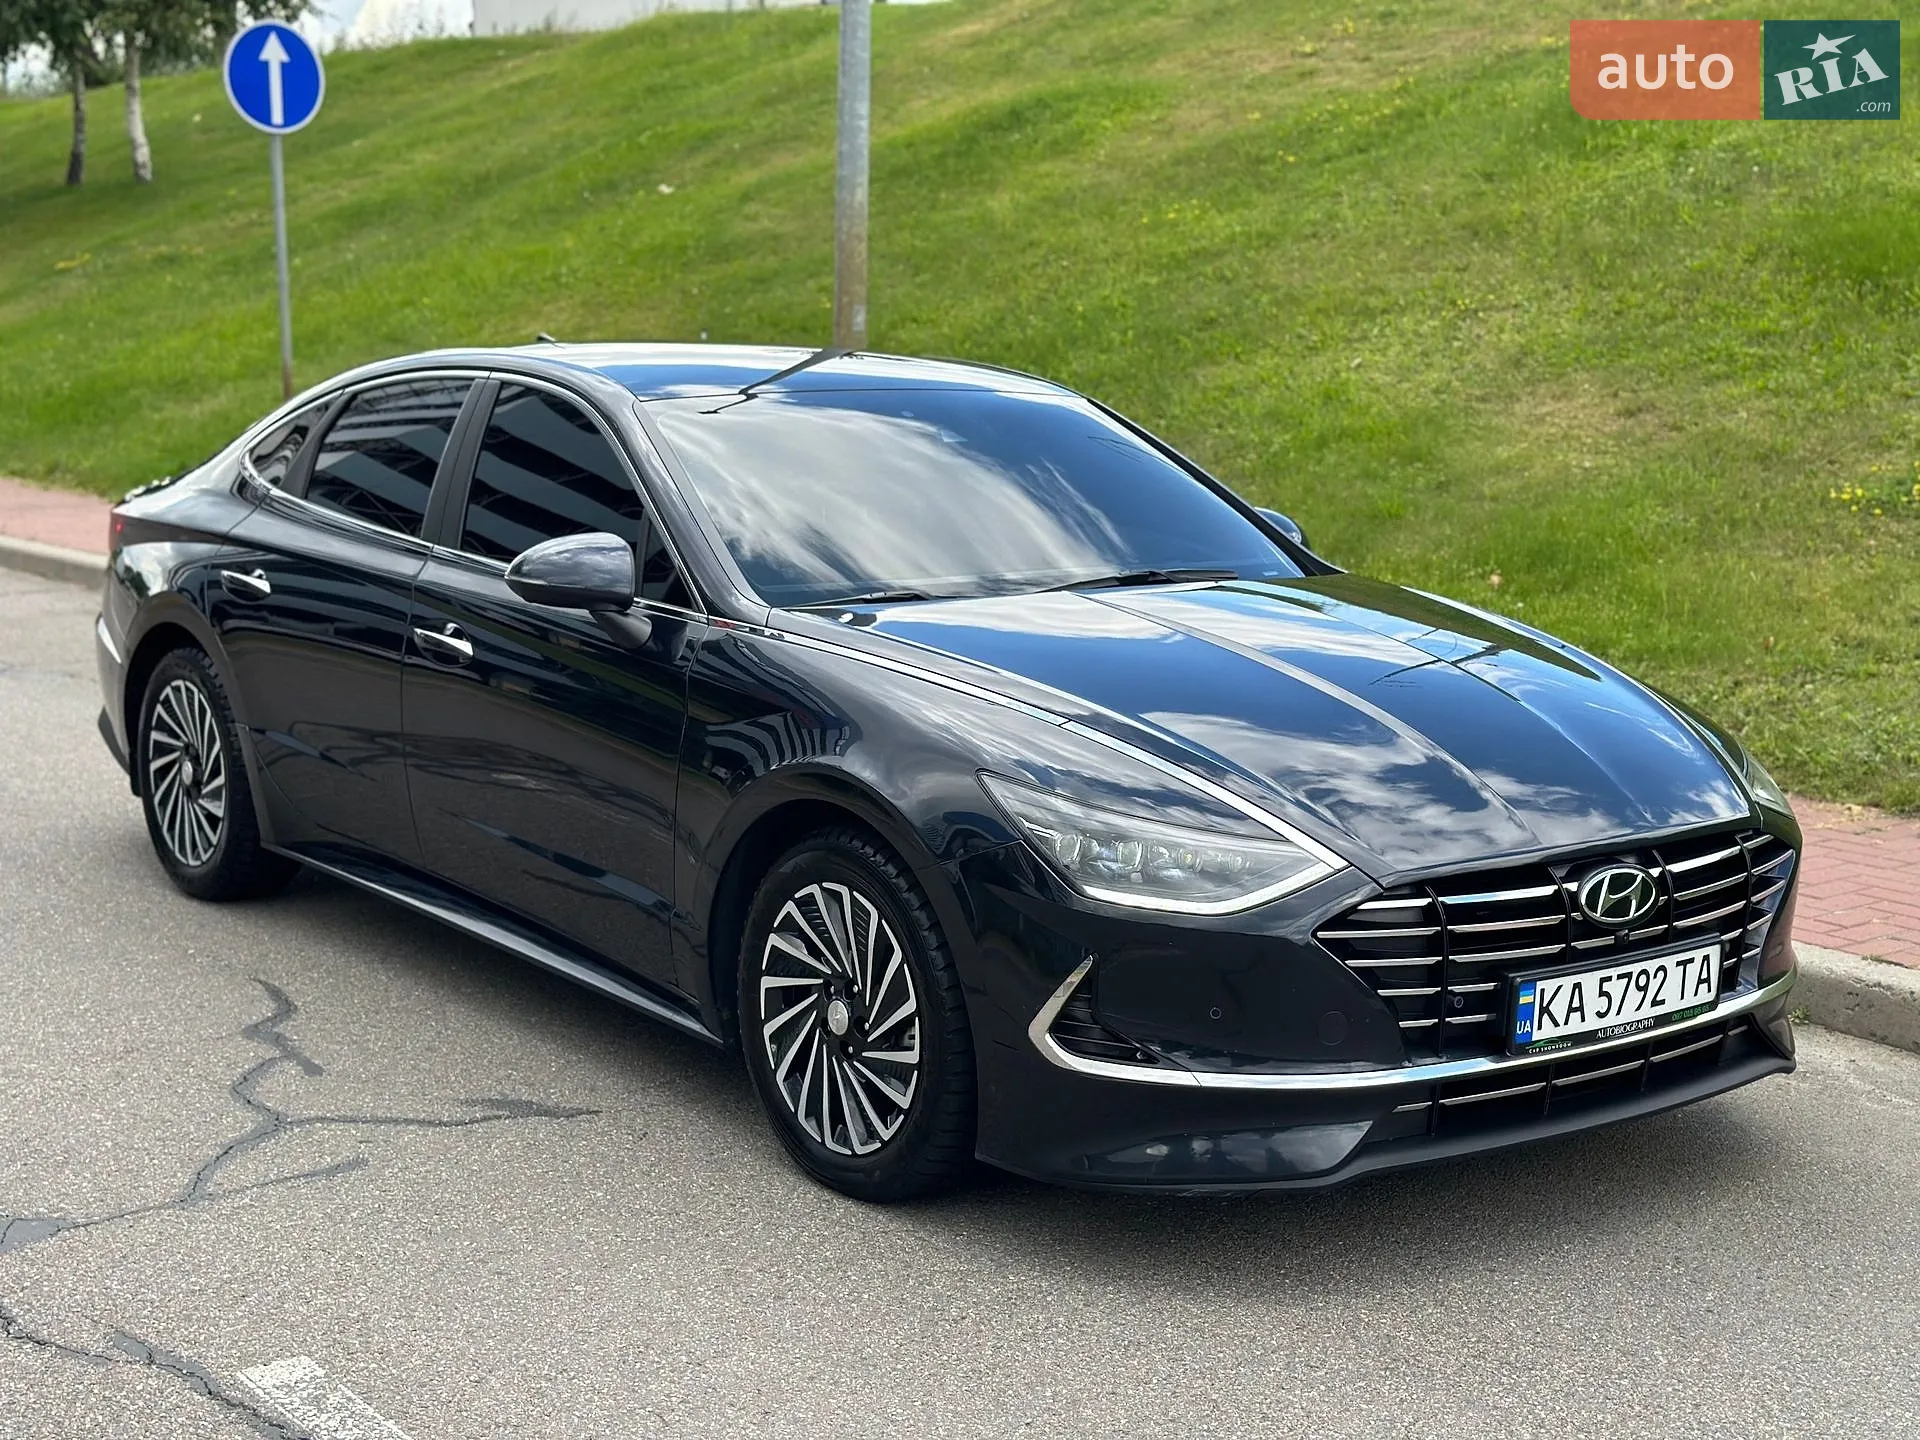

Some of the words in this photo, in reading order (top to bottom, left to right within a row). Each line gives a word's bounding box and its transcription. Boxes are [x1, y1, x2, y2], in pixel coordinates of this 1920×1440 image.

[1537, 981, 1586, 1031] KA
[1595, 964, 1668, 1019] 5792
[1675, 953, 1712, 1001] TA
[1516, 1020, 1532, 1035] UA
[1596, 1017, 1656, 1039] AUTOBIOGRAPHY
